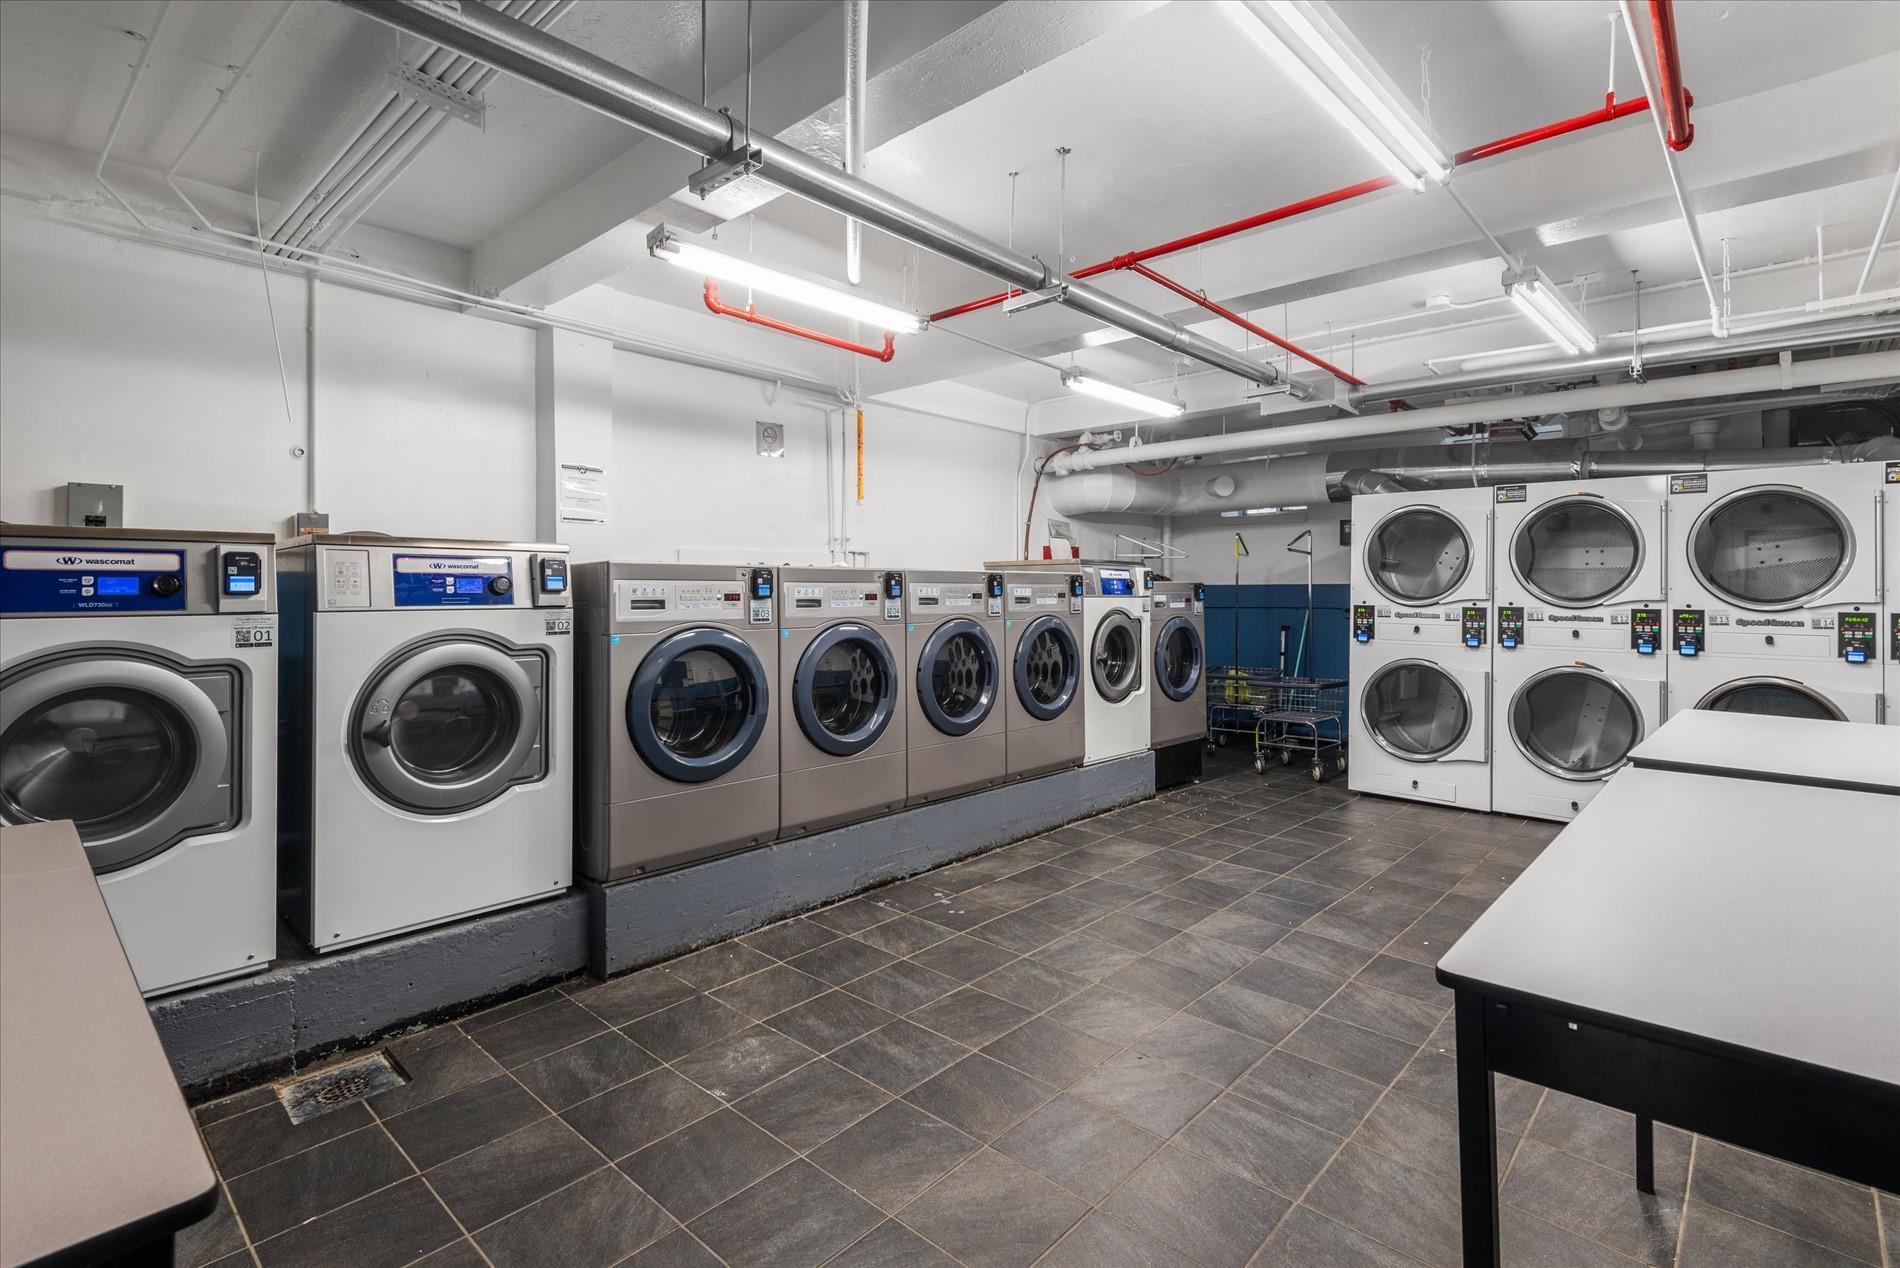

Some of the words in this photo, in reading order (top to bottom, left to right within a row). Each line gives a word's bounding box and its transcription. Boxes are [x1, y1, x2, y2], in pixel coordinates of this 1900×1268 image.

[760, 609, 770, 617] 03
[557, 620, 570, 630] 02
[253, 630, 272, 641] 01
